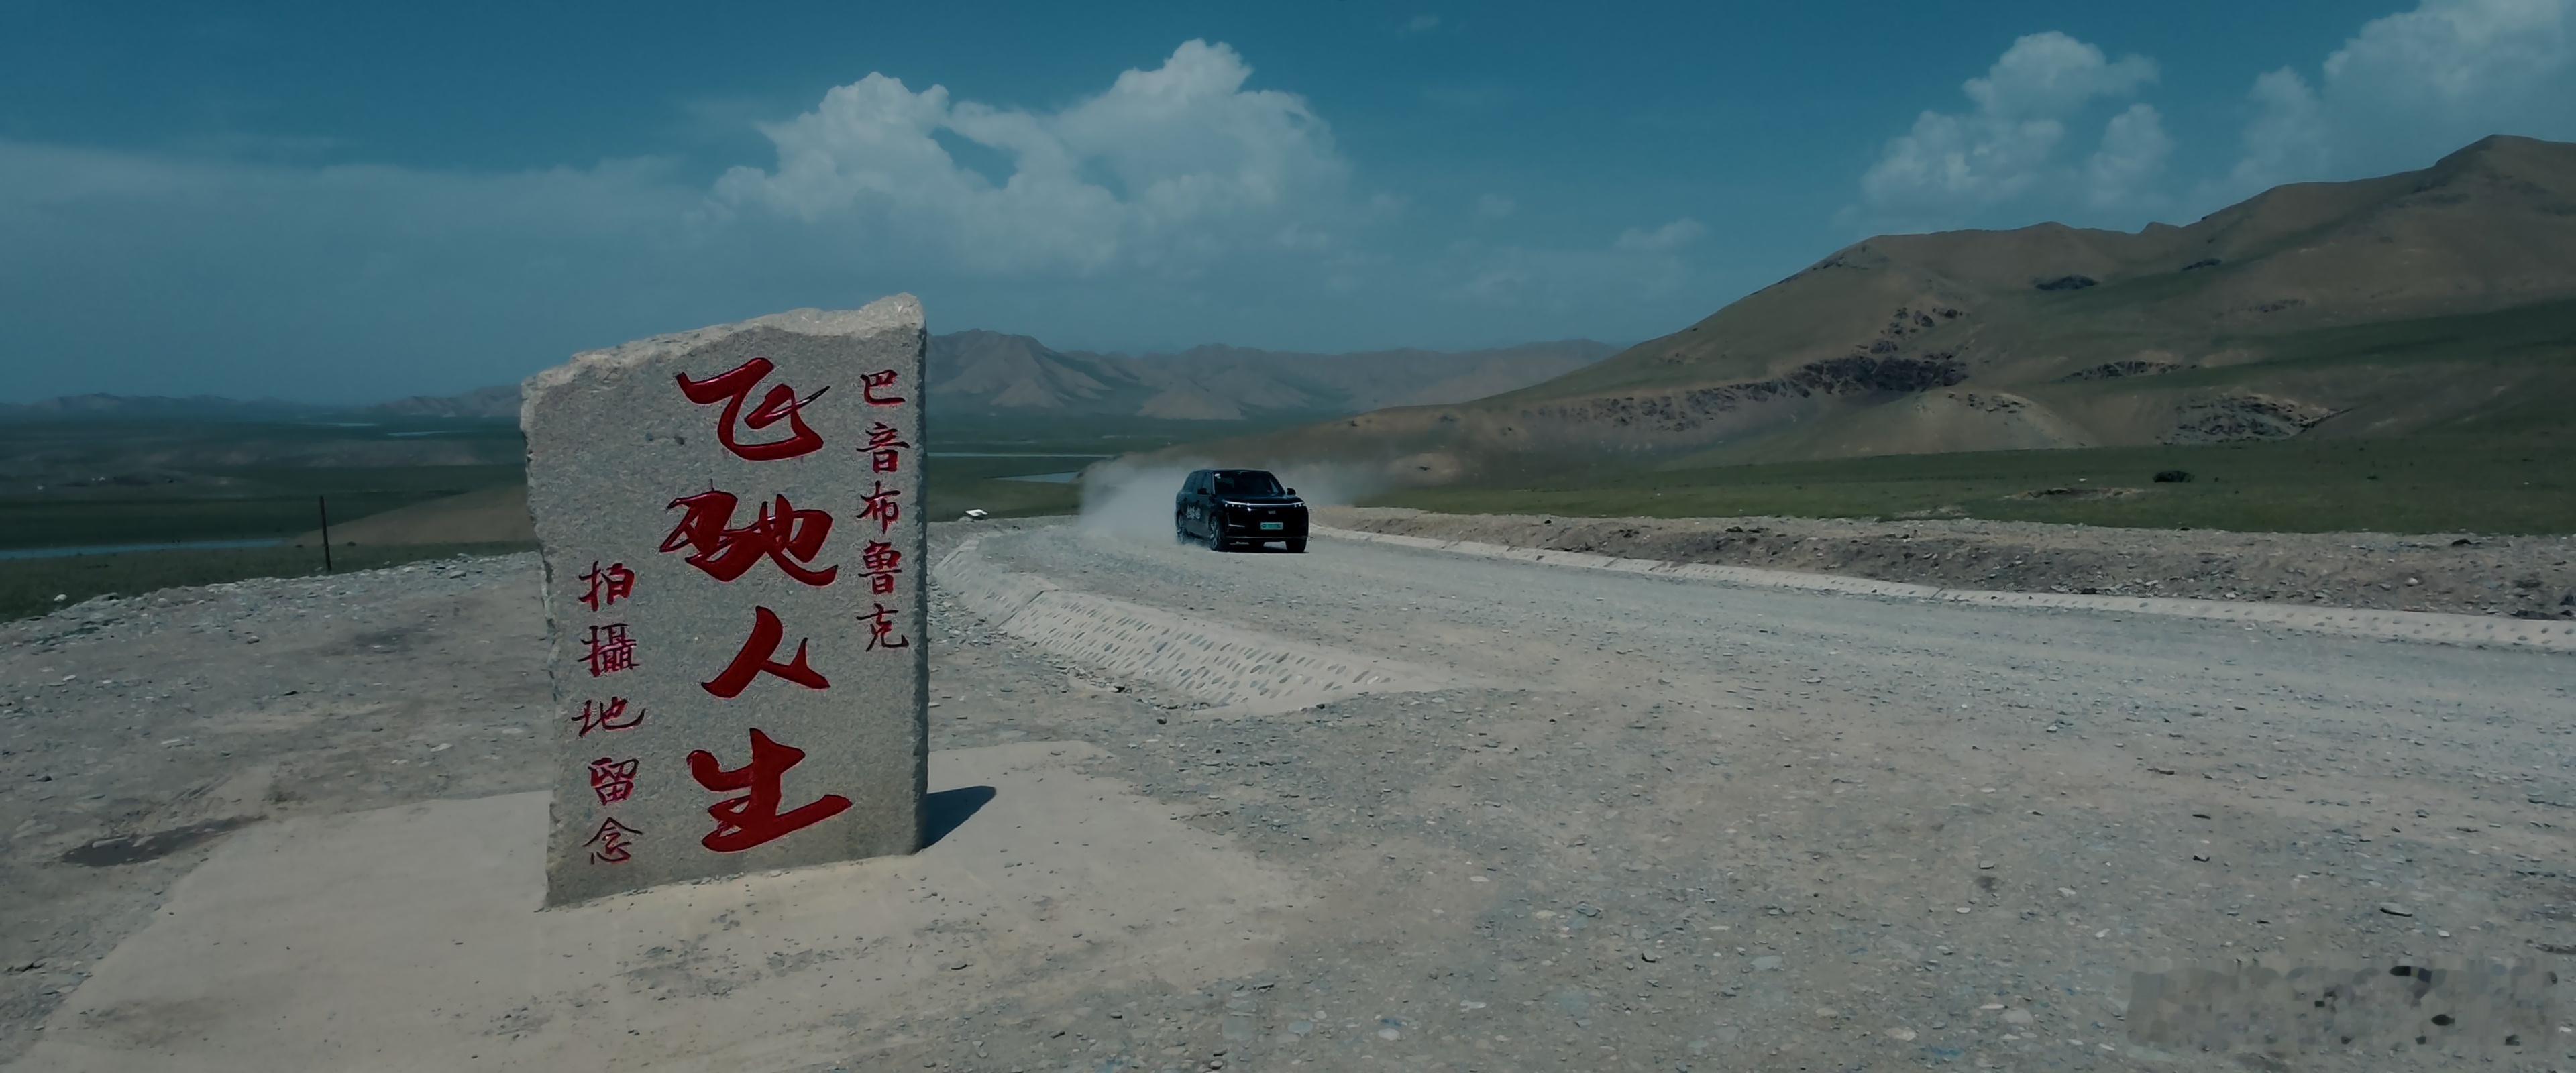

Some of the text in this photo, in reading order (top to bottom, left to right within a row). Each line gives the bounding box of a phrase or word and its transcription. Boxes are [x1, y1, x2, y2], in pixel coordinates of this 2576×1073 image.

[659, 357, 853, 852] 飞驰人生
[856, 369, 910, 652] 巴音布鲁克
